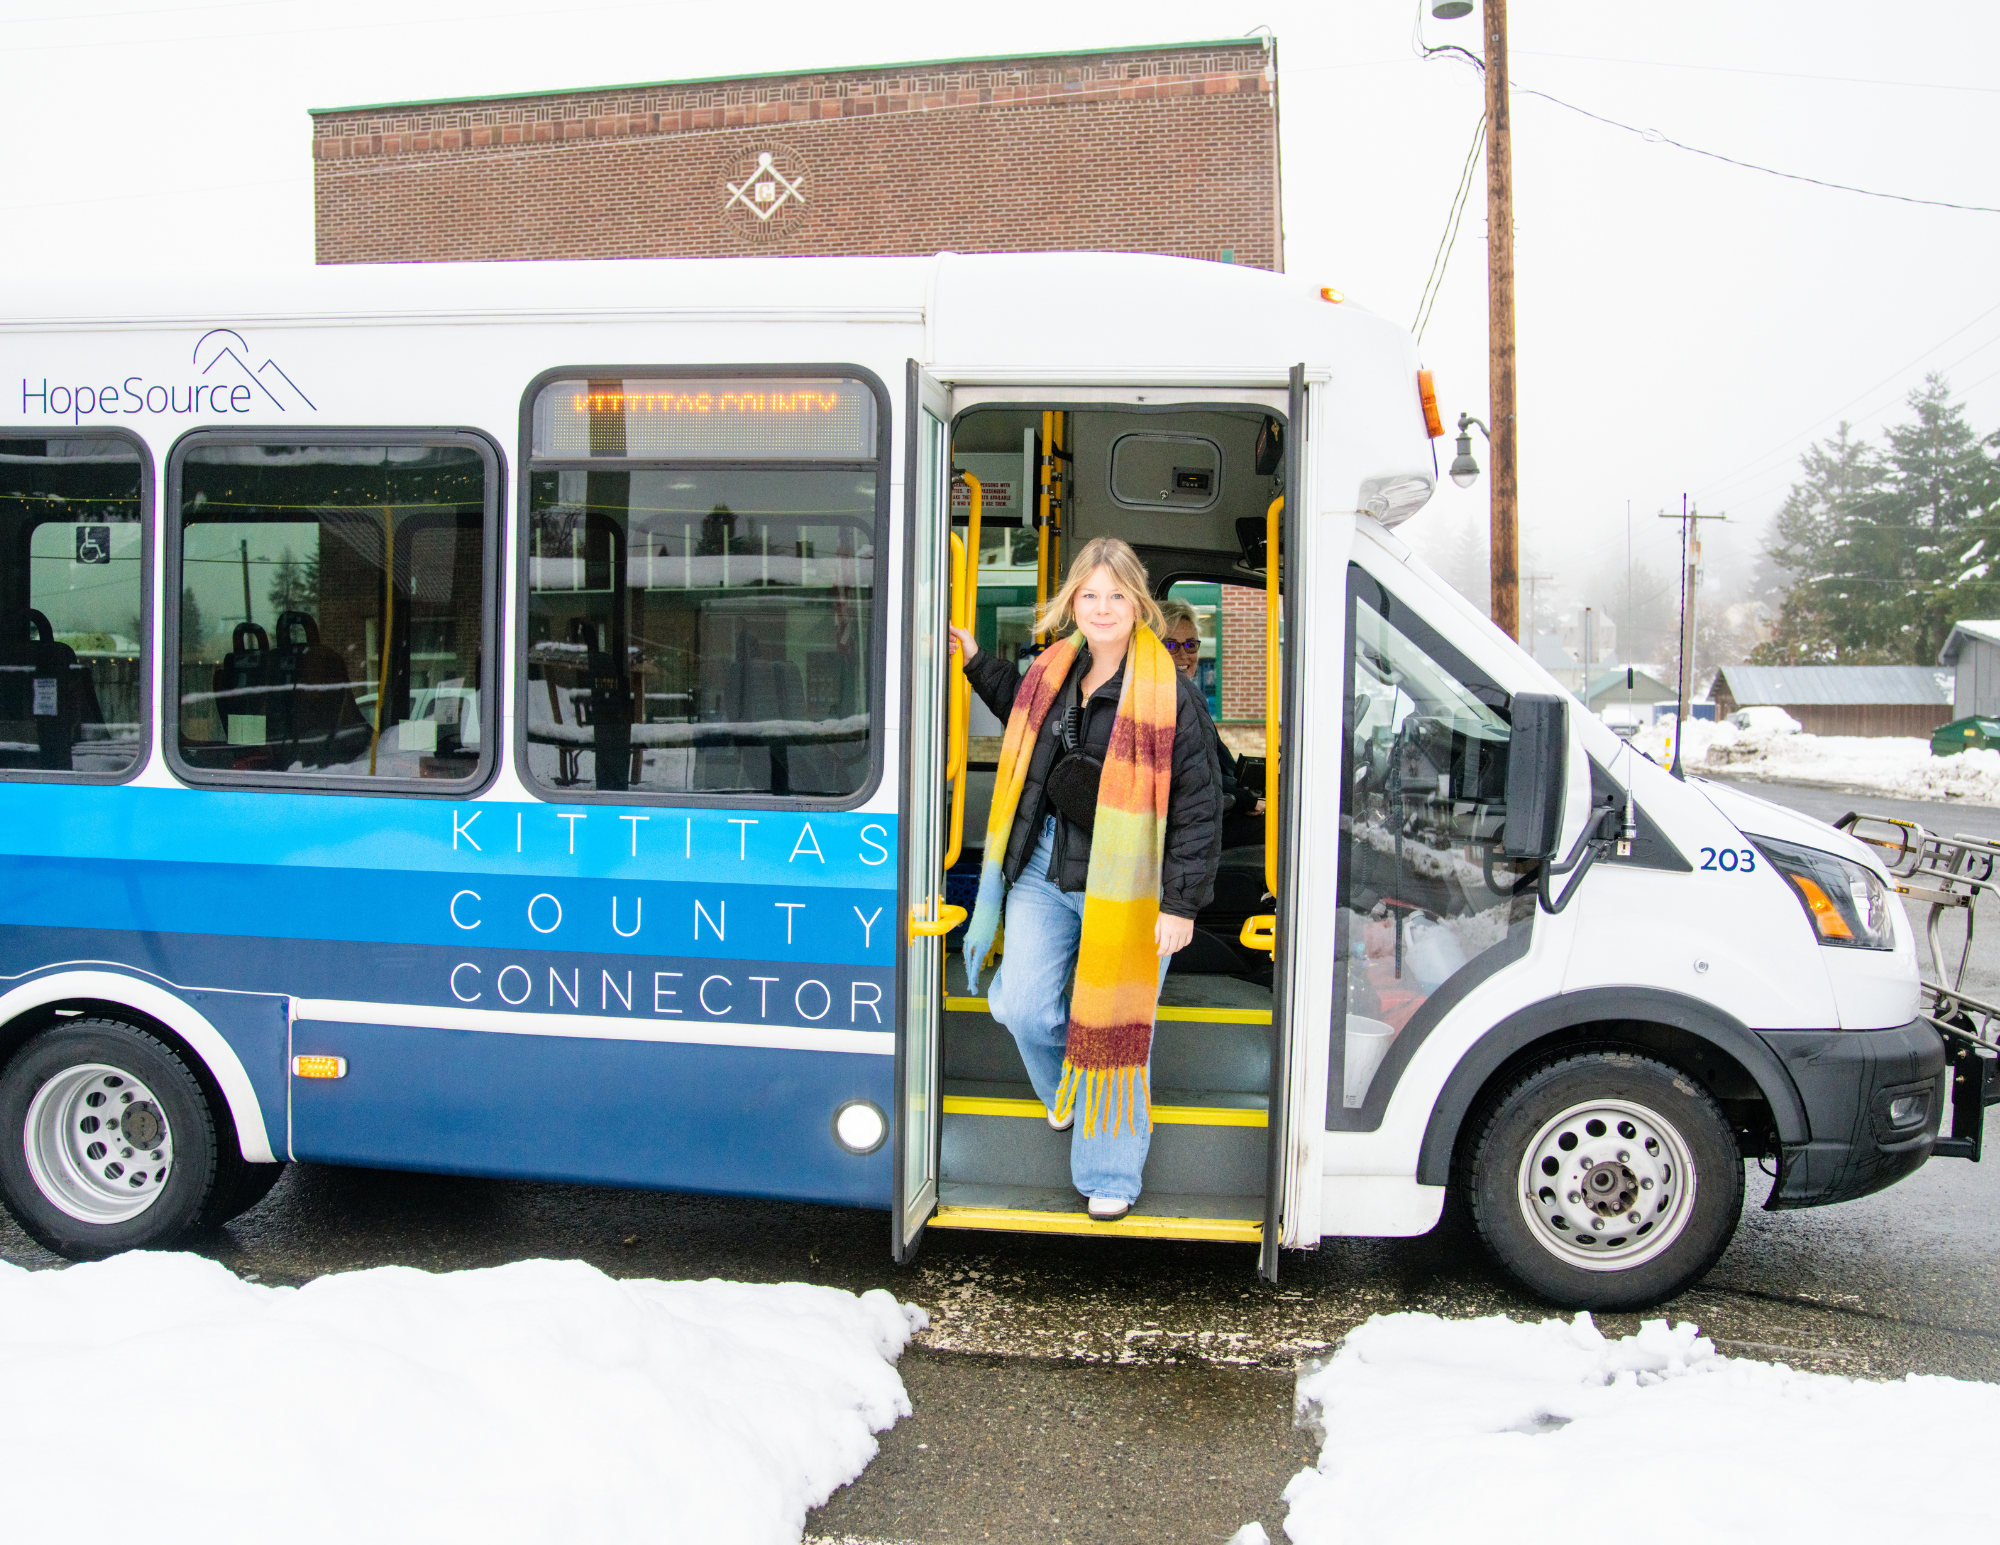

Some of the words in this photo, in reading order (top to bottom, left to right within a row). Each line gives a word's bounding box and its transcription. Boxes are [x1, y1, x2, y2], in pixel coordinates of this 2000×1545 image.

[759, 184, 771, 200] G
[23, 377, 250, 425] HopeSource
[453, 809, 888, 866] KITTITAS
[1700, 847, 1756, 873] 203
[450, 890, 883, 948] COUNTY
[450, 962, 882, 1023] CONNECTOR
